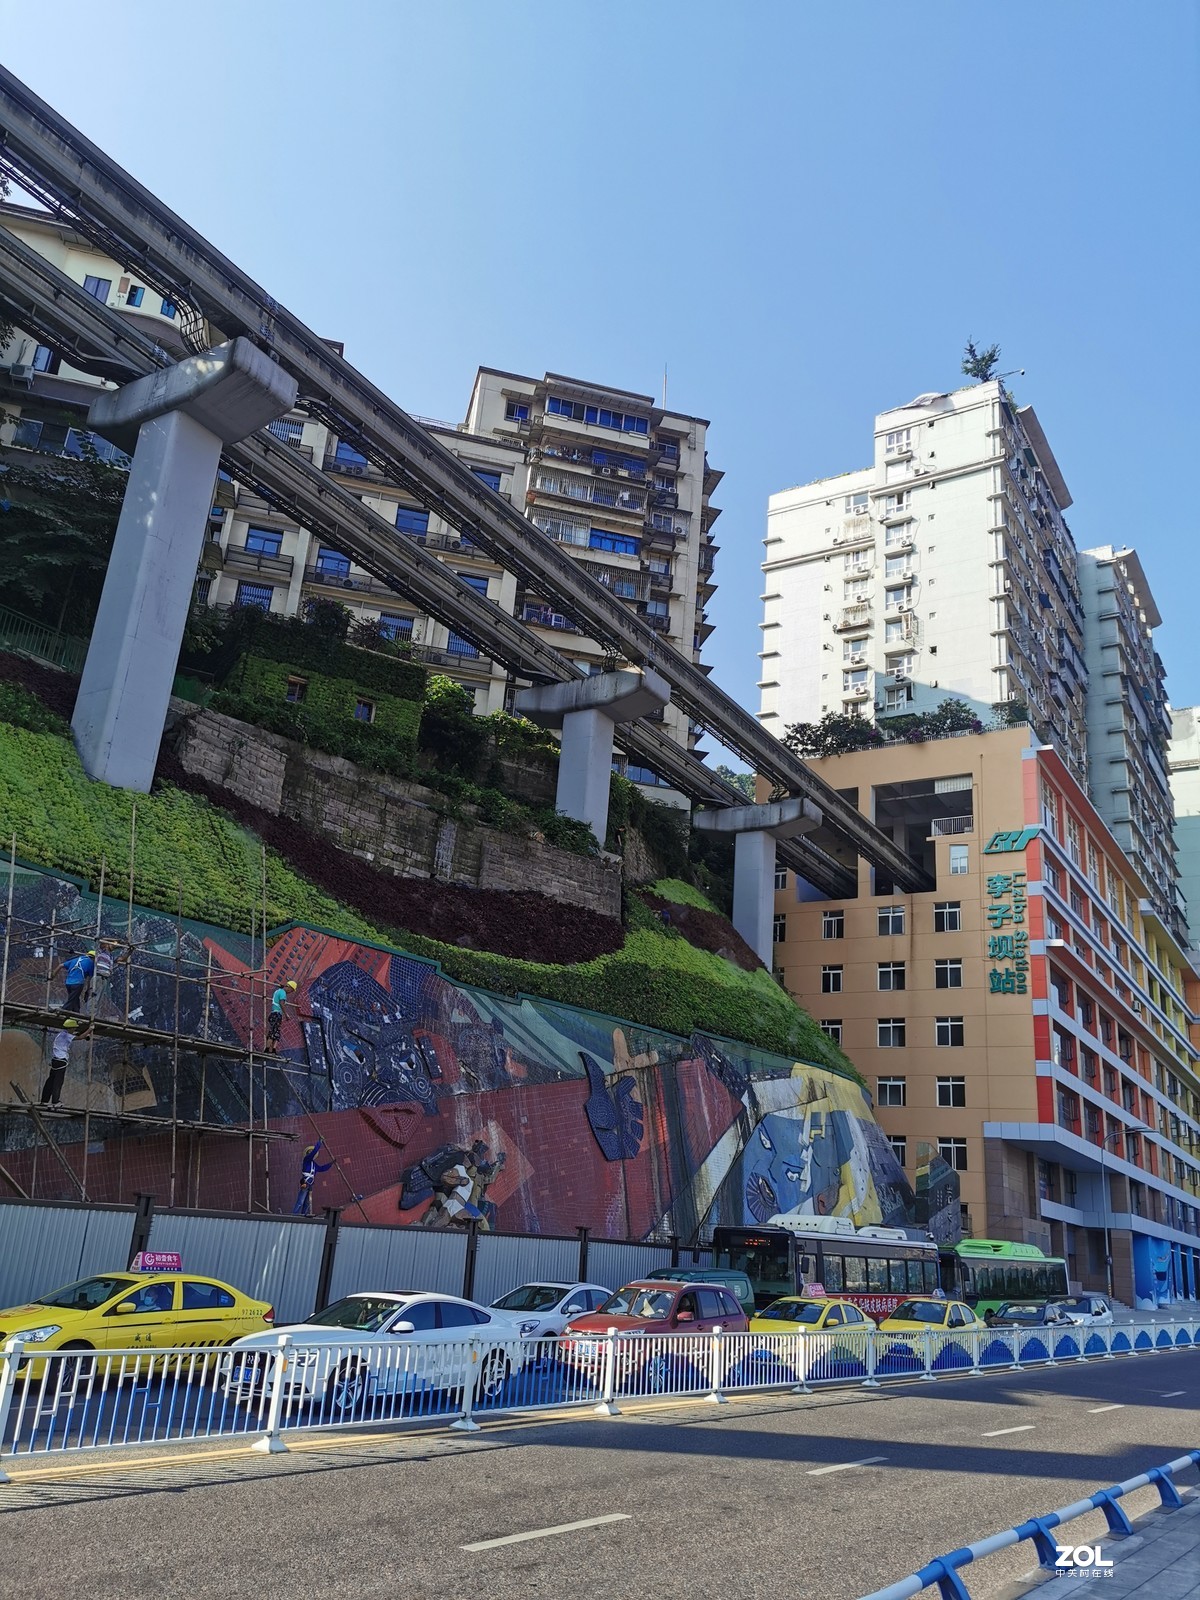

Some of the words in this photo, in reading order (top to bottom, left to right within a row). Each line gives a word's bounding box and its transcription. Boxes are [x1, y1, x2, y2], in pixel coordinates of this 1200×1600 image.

[1012, 871, 1027, 924] Liziba
[987, 874, 1015, 995] 李子坝站
[1014, 929, 1029, 995] Station
